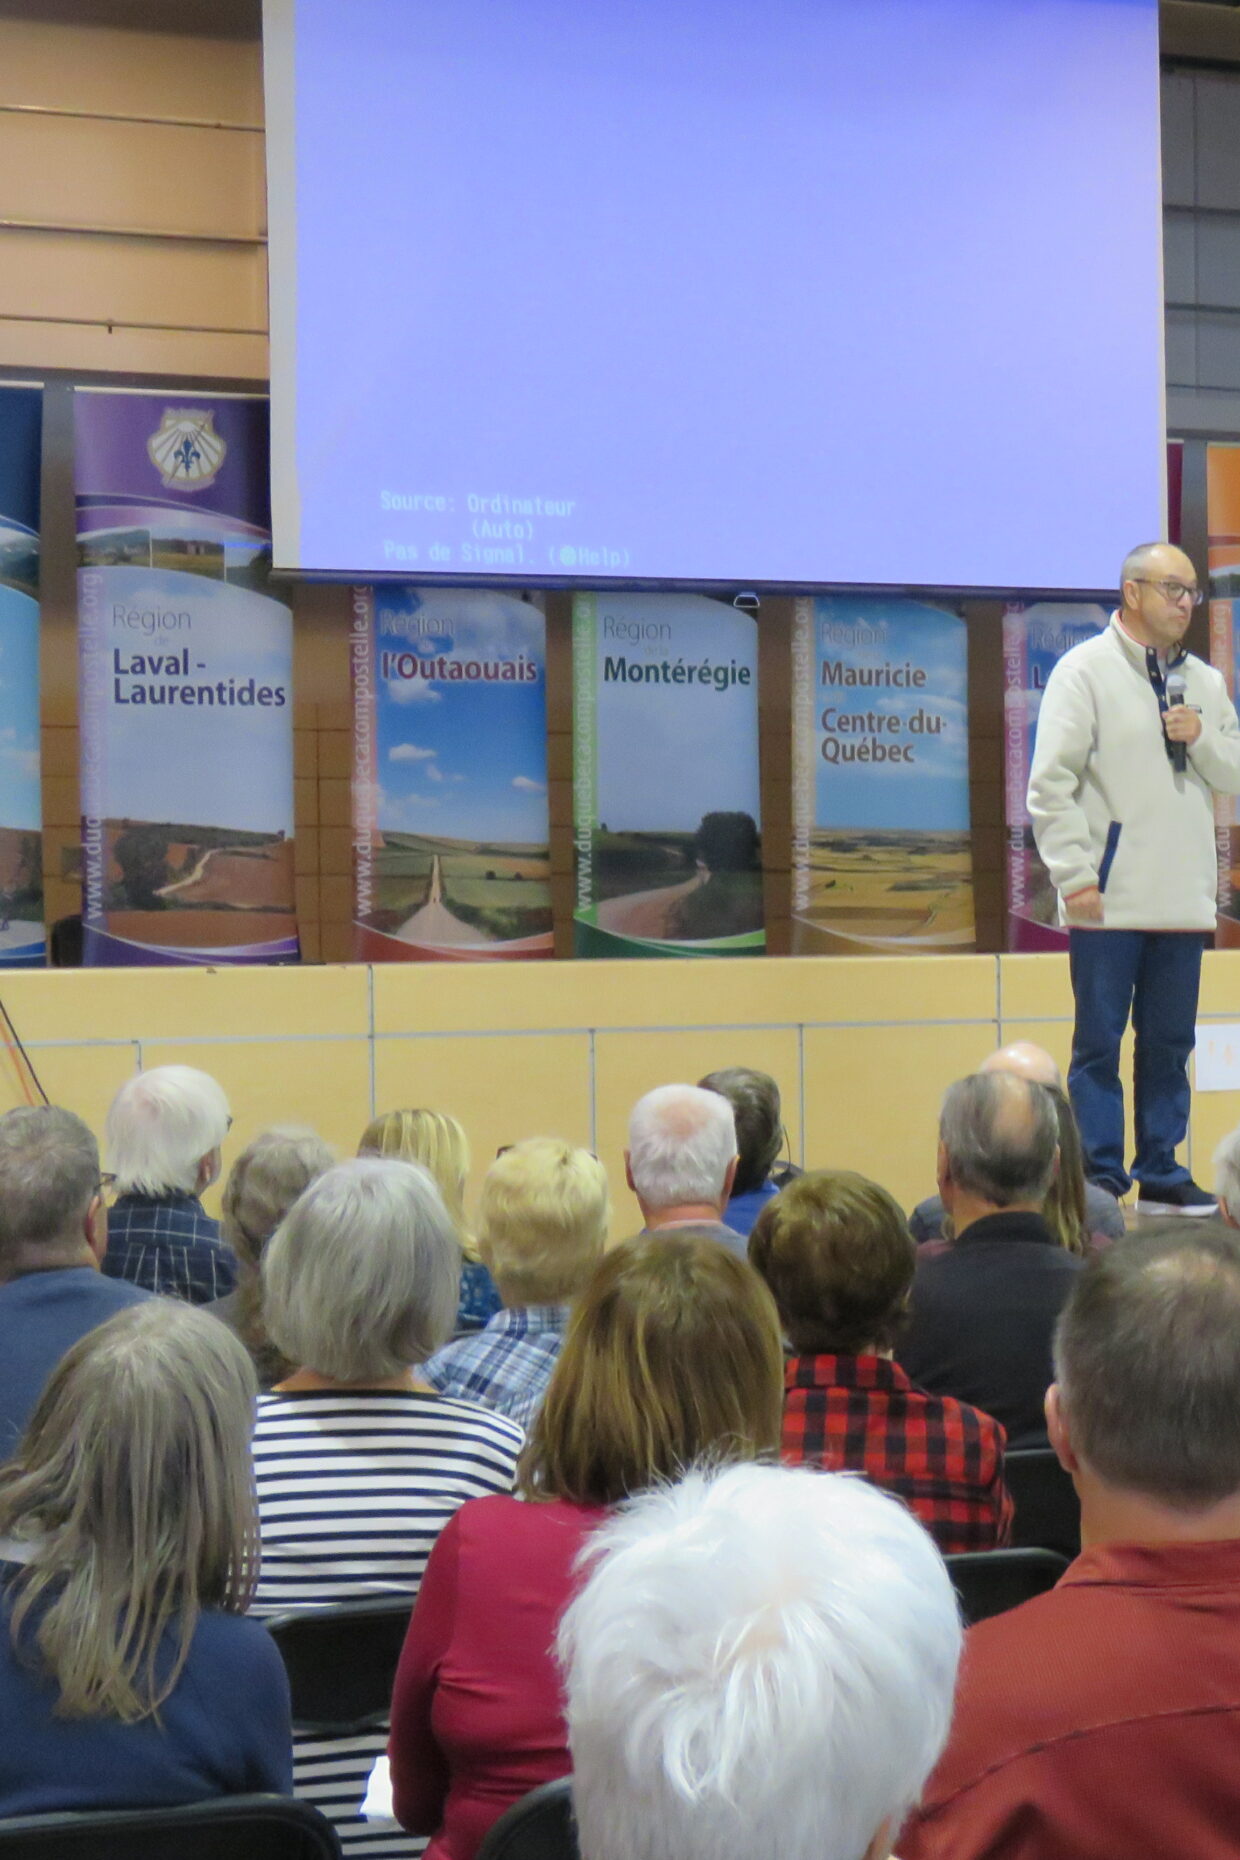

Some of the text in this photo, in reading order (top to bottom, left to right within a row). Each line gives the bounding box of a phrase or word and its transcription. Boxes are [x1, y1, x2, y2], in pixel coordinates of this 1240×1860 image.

[380, 490, 577, 517] Source: Ordinateur
[472, 520, 533, 540] (Auto)
[383, 540, 418, 561] Pas
[429, 542, 451, 562] de
[112, 604, 191, 636] Région
[603, 615, 672, 646] Région
[113, 648, 189, 675] Laval
[382, 652, 537, 681] l'Outaouais
[604, 656, 751, 692] Montérégie
[821, 660, 927, 687] Mauricie
[114, 678, 286, 707] Laurentides
[821, 736, 915, 765] Québec
